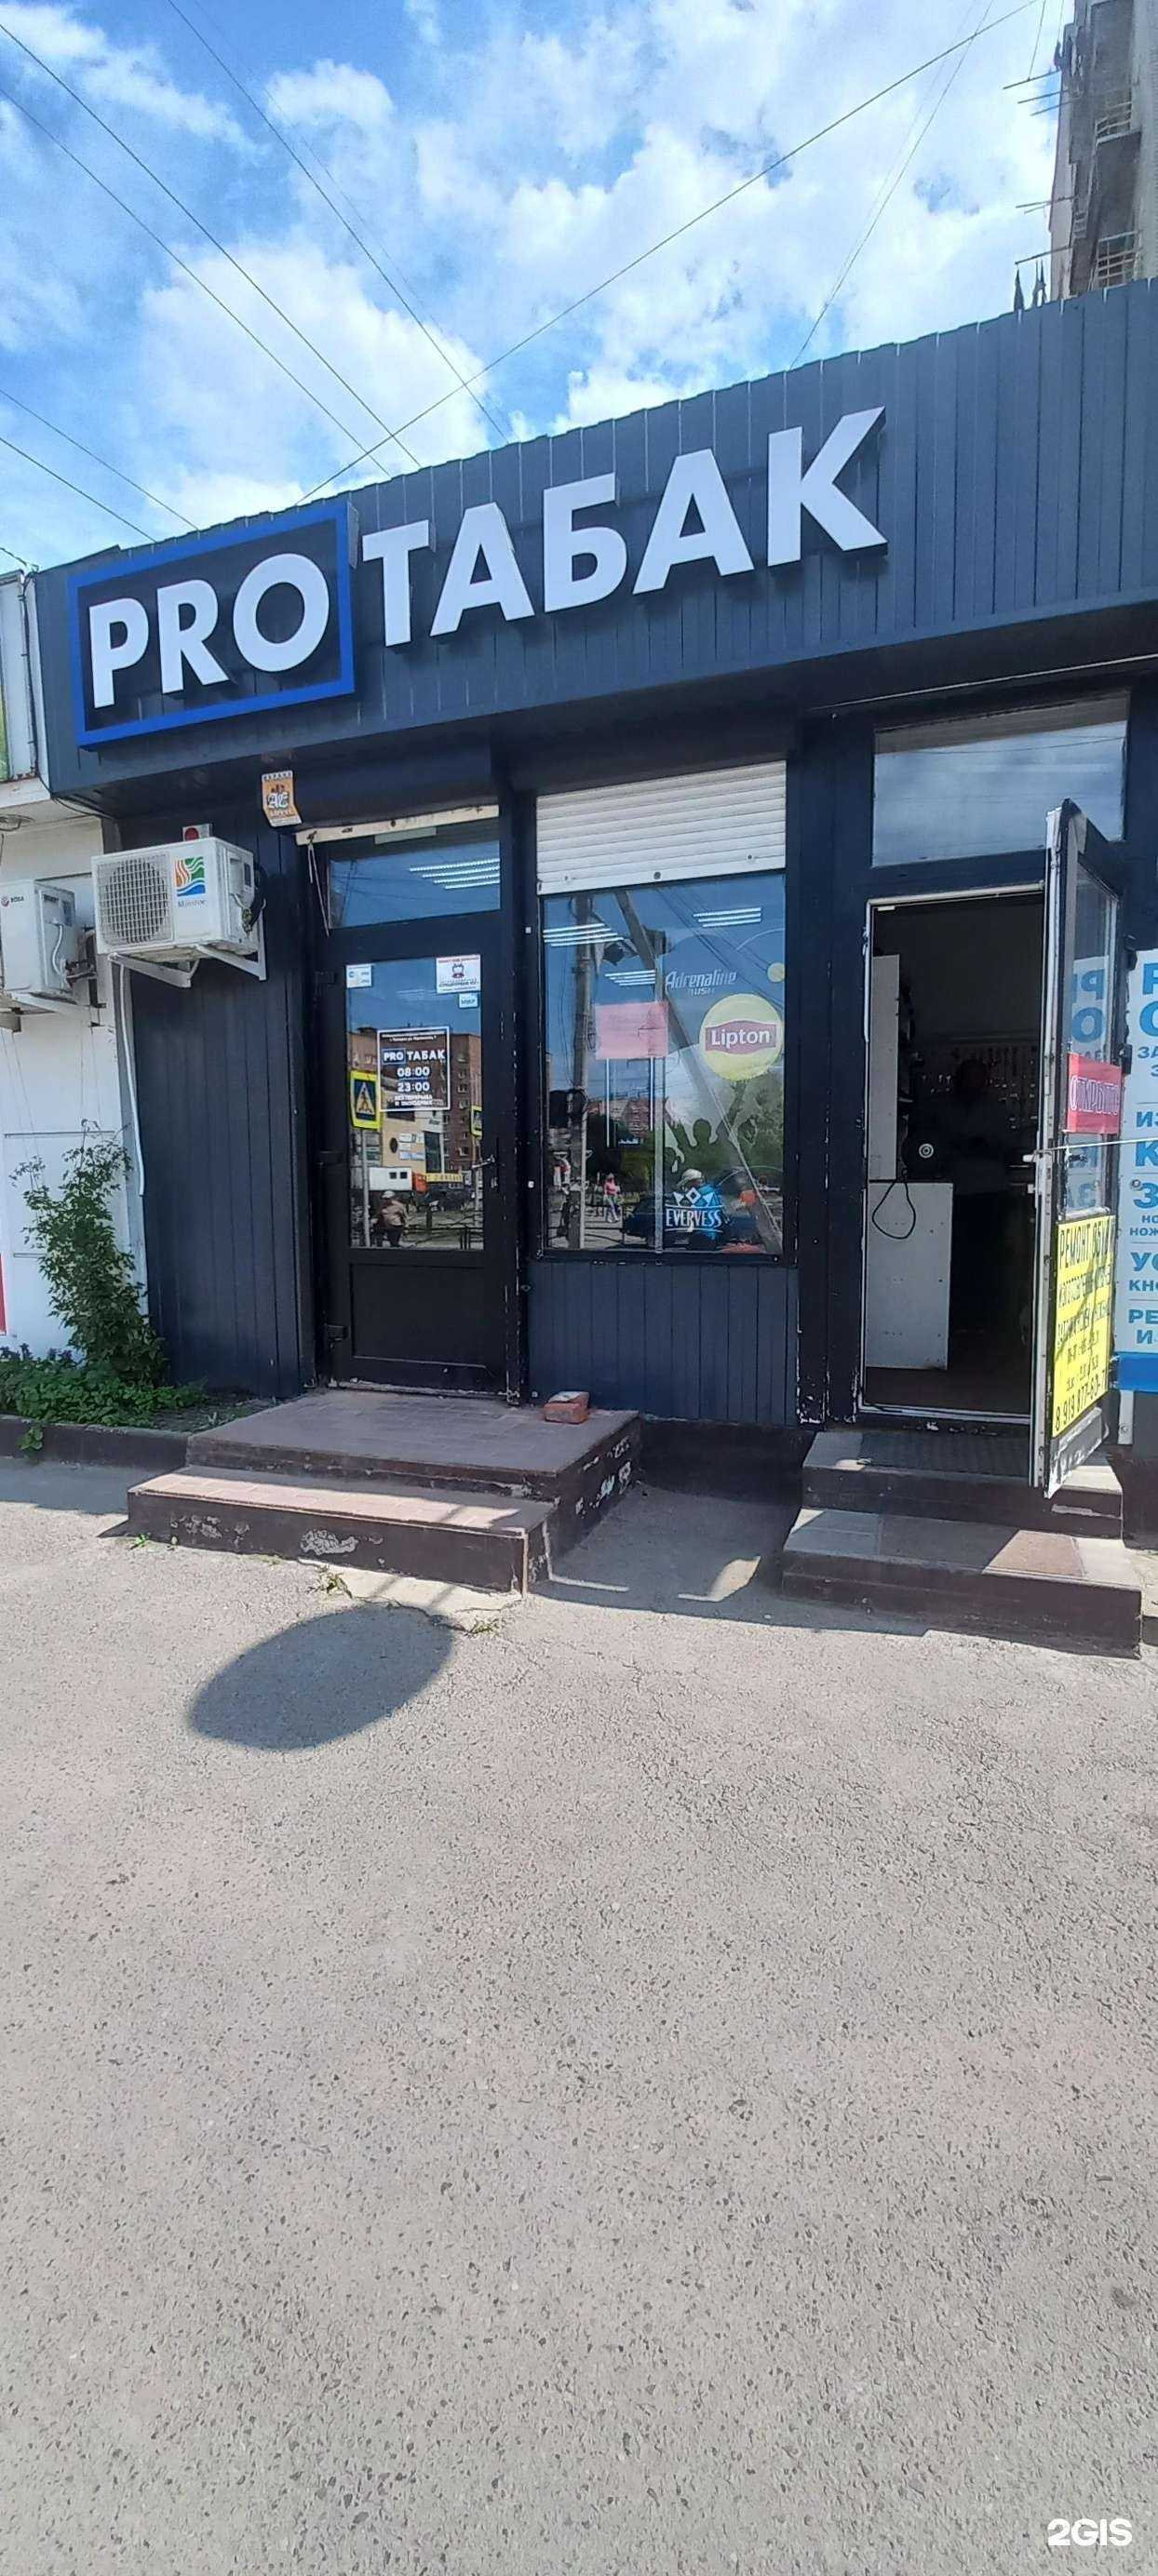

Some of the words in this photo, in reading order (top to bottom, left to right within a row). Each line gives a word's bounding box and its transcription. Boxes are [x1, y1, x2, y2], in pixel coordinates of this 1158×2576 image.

[88, 553, 330, 708] PRO
[361, 406, 888, 648] ТАБАК
[665, 969, 737, 995] Adrenaline
[710, 1028, 771, 1050] Lipton
[384, 1052, 404, 1062] PRO
[407, 1049, 446, 1062] ТАБАК
[397, 1066, 430, 1078] 08:00
[397, 1080, 430, 1093] 23:00
[666, 1208, 722, 1228] EVERVESS
[1129, 1279, 1158, 1292] КН
